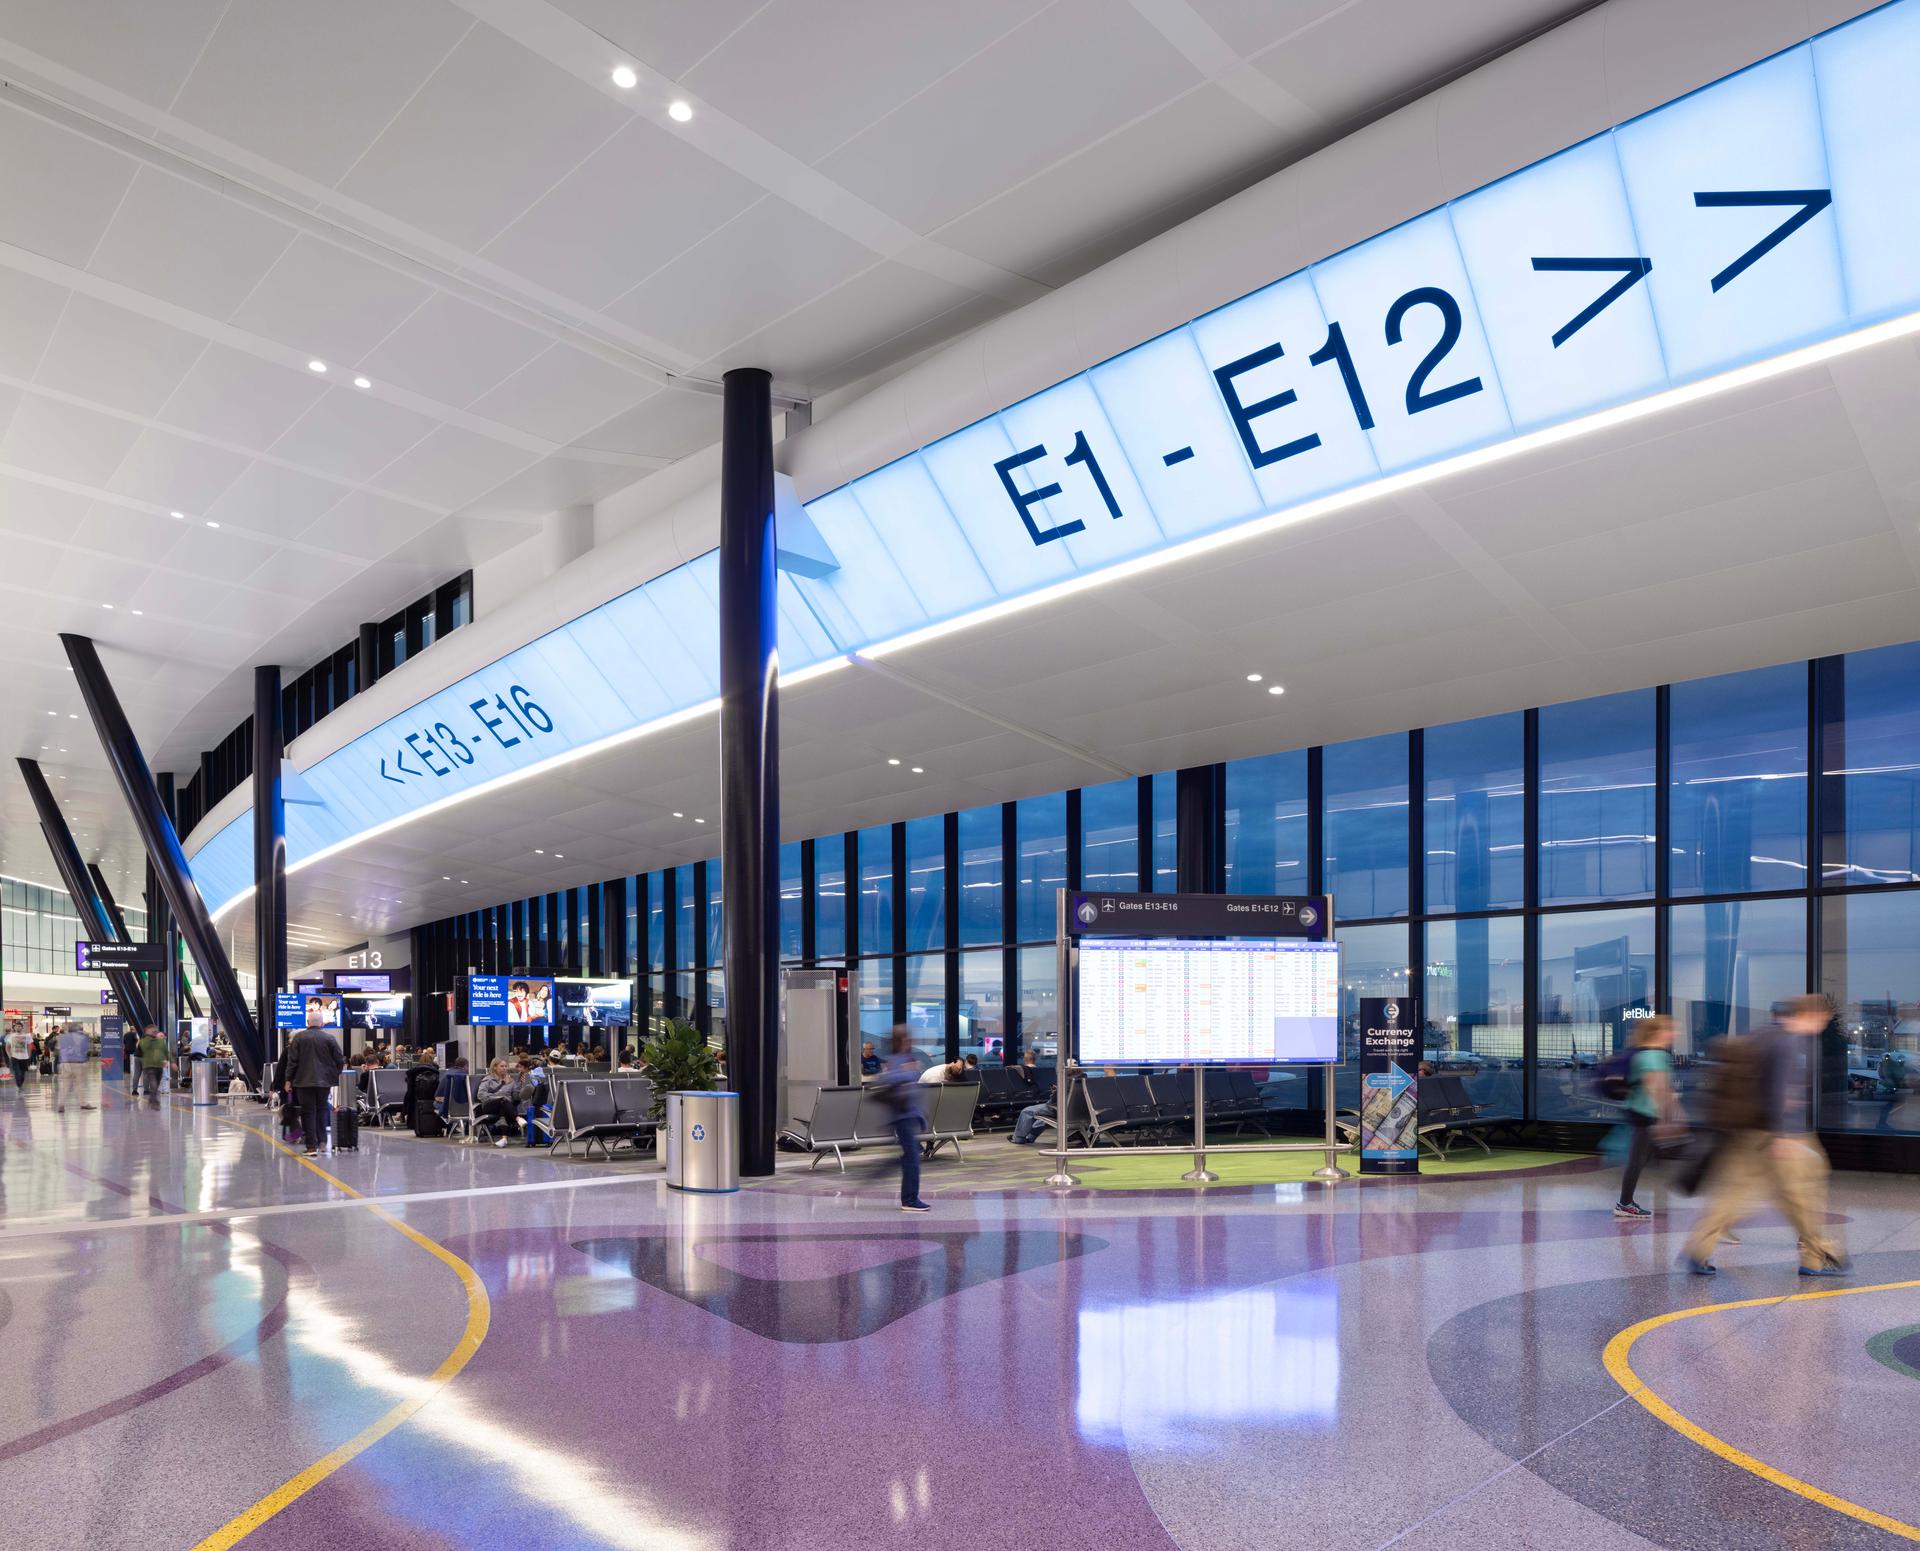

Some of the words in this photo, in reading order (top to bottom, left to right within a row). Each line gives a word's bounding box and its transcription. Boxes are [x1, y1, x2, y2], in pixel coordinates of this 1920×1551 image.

[993, 430, 1124, 547] E1
[1212, 286, 1484, 470] E12
[1119, 902, 1143, 911] Gates
[1145, 902, 1178, 911] E13-E16
[1226, 903, 1250, 912] Gates
[1251, 904, 1279, 913] E1-E12
[349, 951, 383, 969] E13
[1622, 1008, 1656, 1021] jetBlue
[1367, 1027, 1414, 1038] Currency
[1365, 1037, 1415, 1047] Exchange
